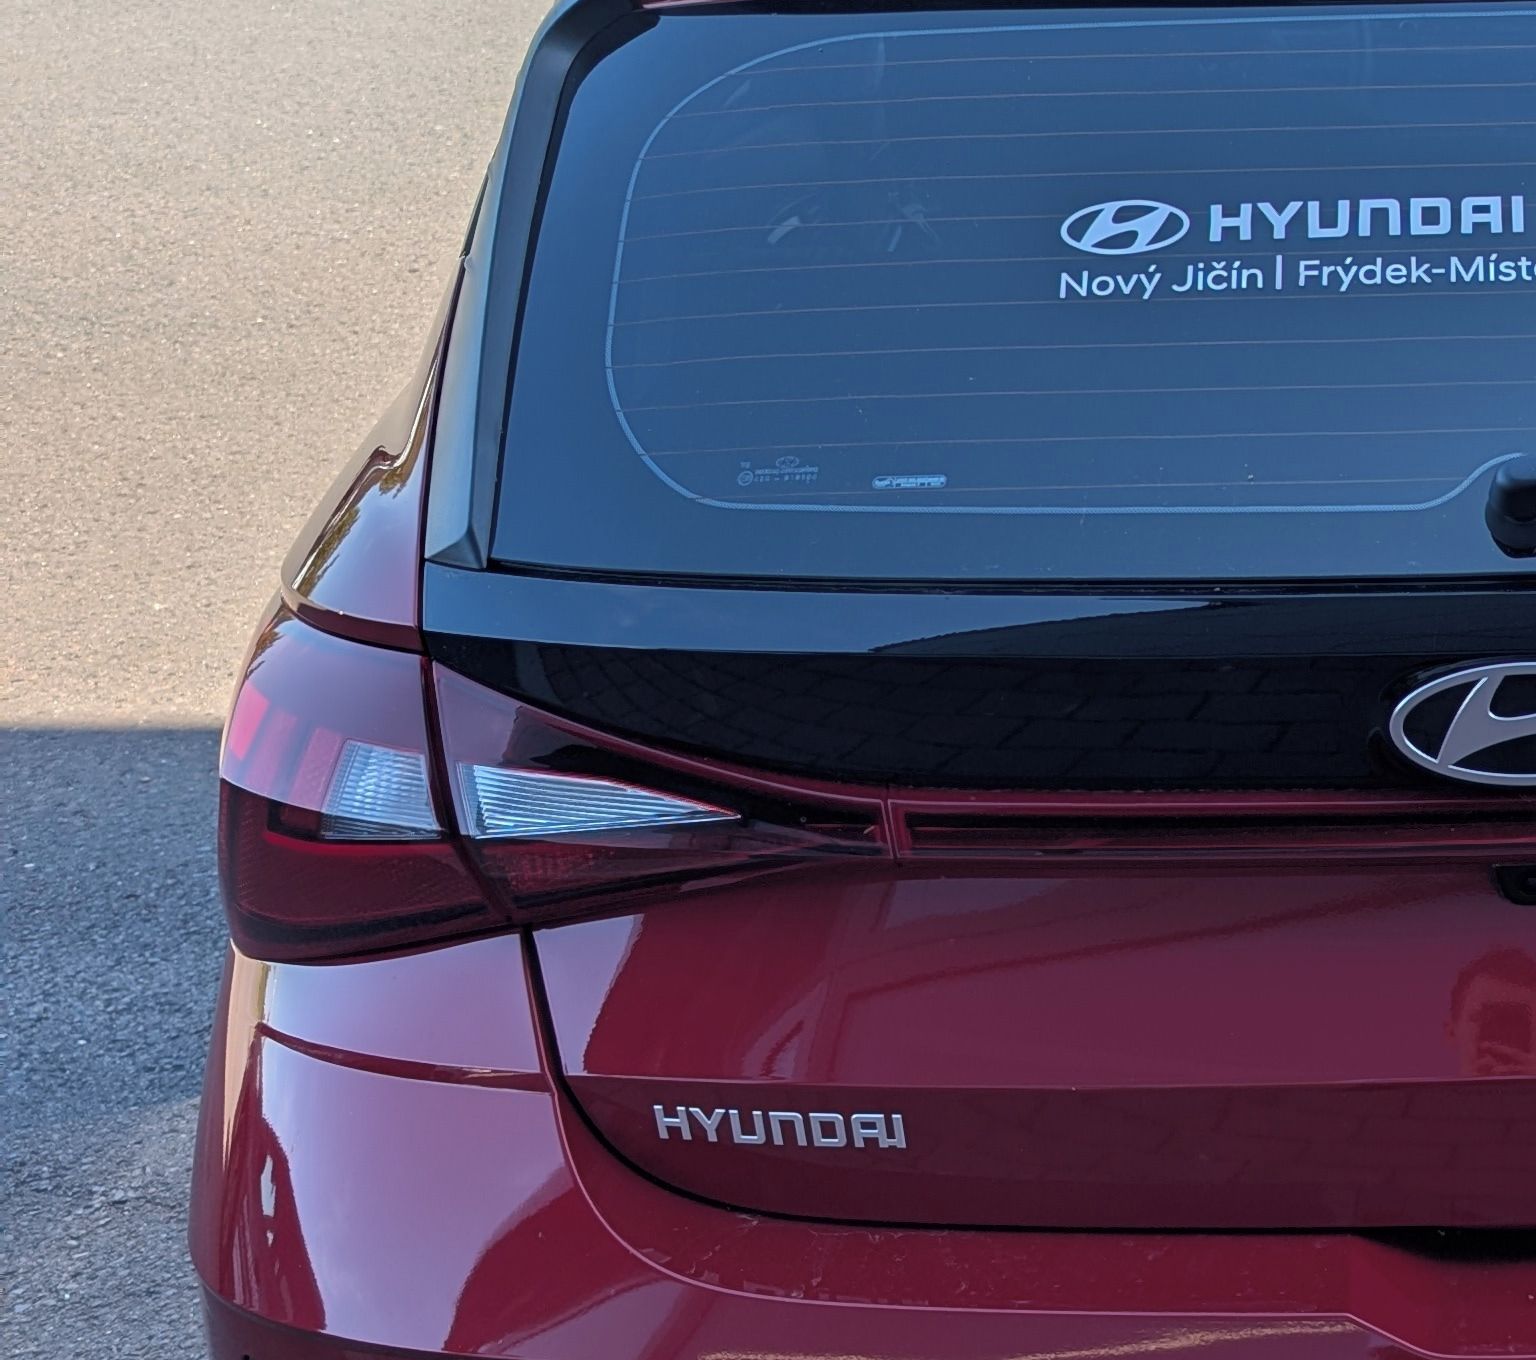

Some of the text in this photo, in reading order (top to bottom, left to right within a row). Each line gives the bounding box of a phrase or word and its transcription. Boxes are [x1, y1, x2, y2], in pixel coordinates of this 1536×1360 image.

[1210, 195, 1526, 242] HYUNDAI
[1059, 264, 1162, 300] Nový
[1172, 260, 1264, 292] Jičín
[652, 1104, 907, 1149] HYUNDAI
